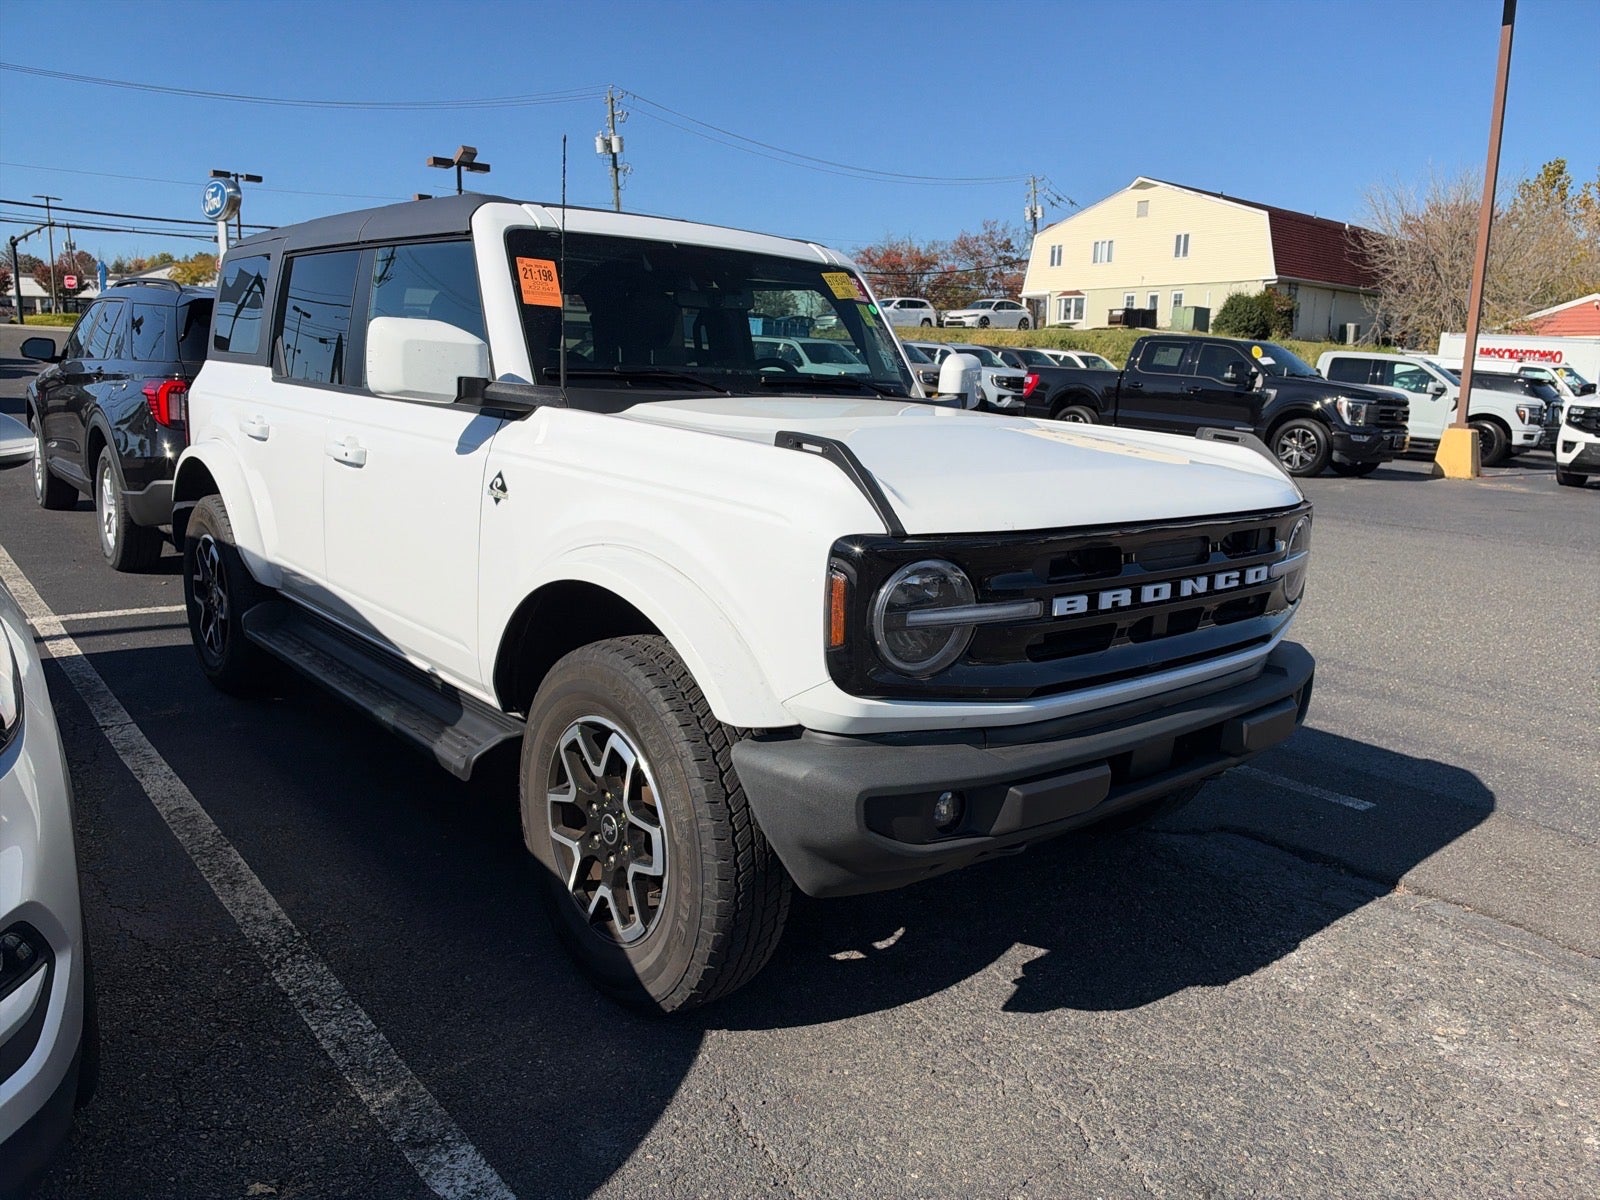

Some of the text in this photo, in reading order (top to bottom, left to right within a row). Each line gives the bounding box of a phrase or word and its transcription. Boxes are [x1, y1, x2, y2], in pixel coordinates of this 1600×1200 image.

[205, 186, 221, 212] Ford
[522, 267, 553, 281] 21:198
[1052, 565, 1268, 616] BRONCO
